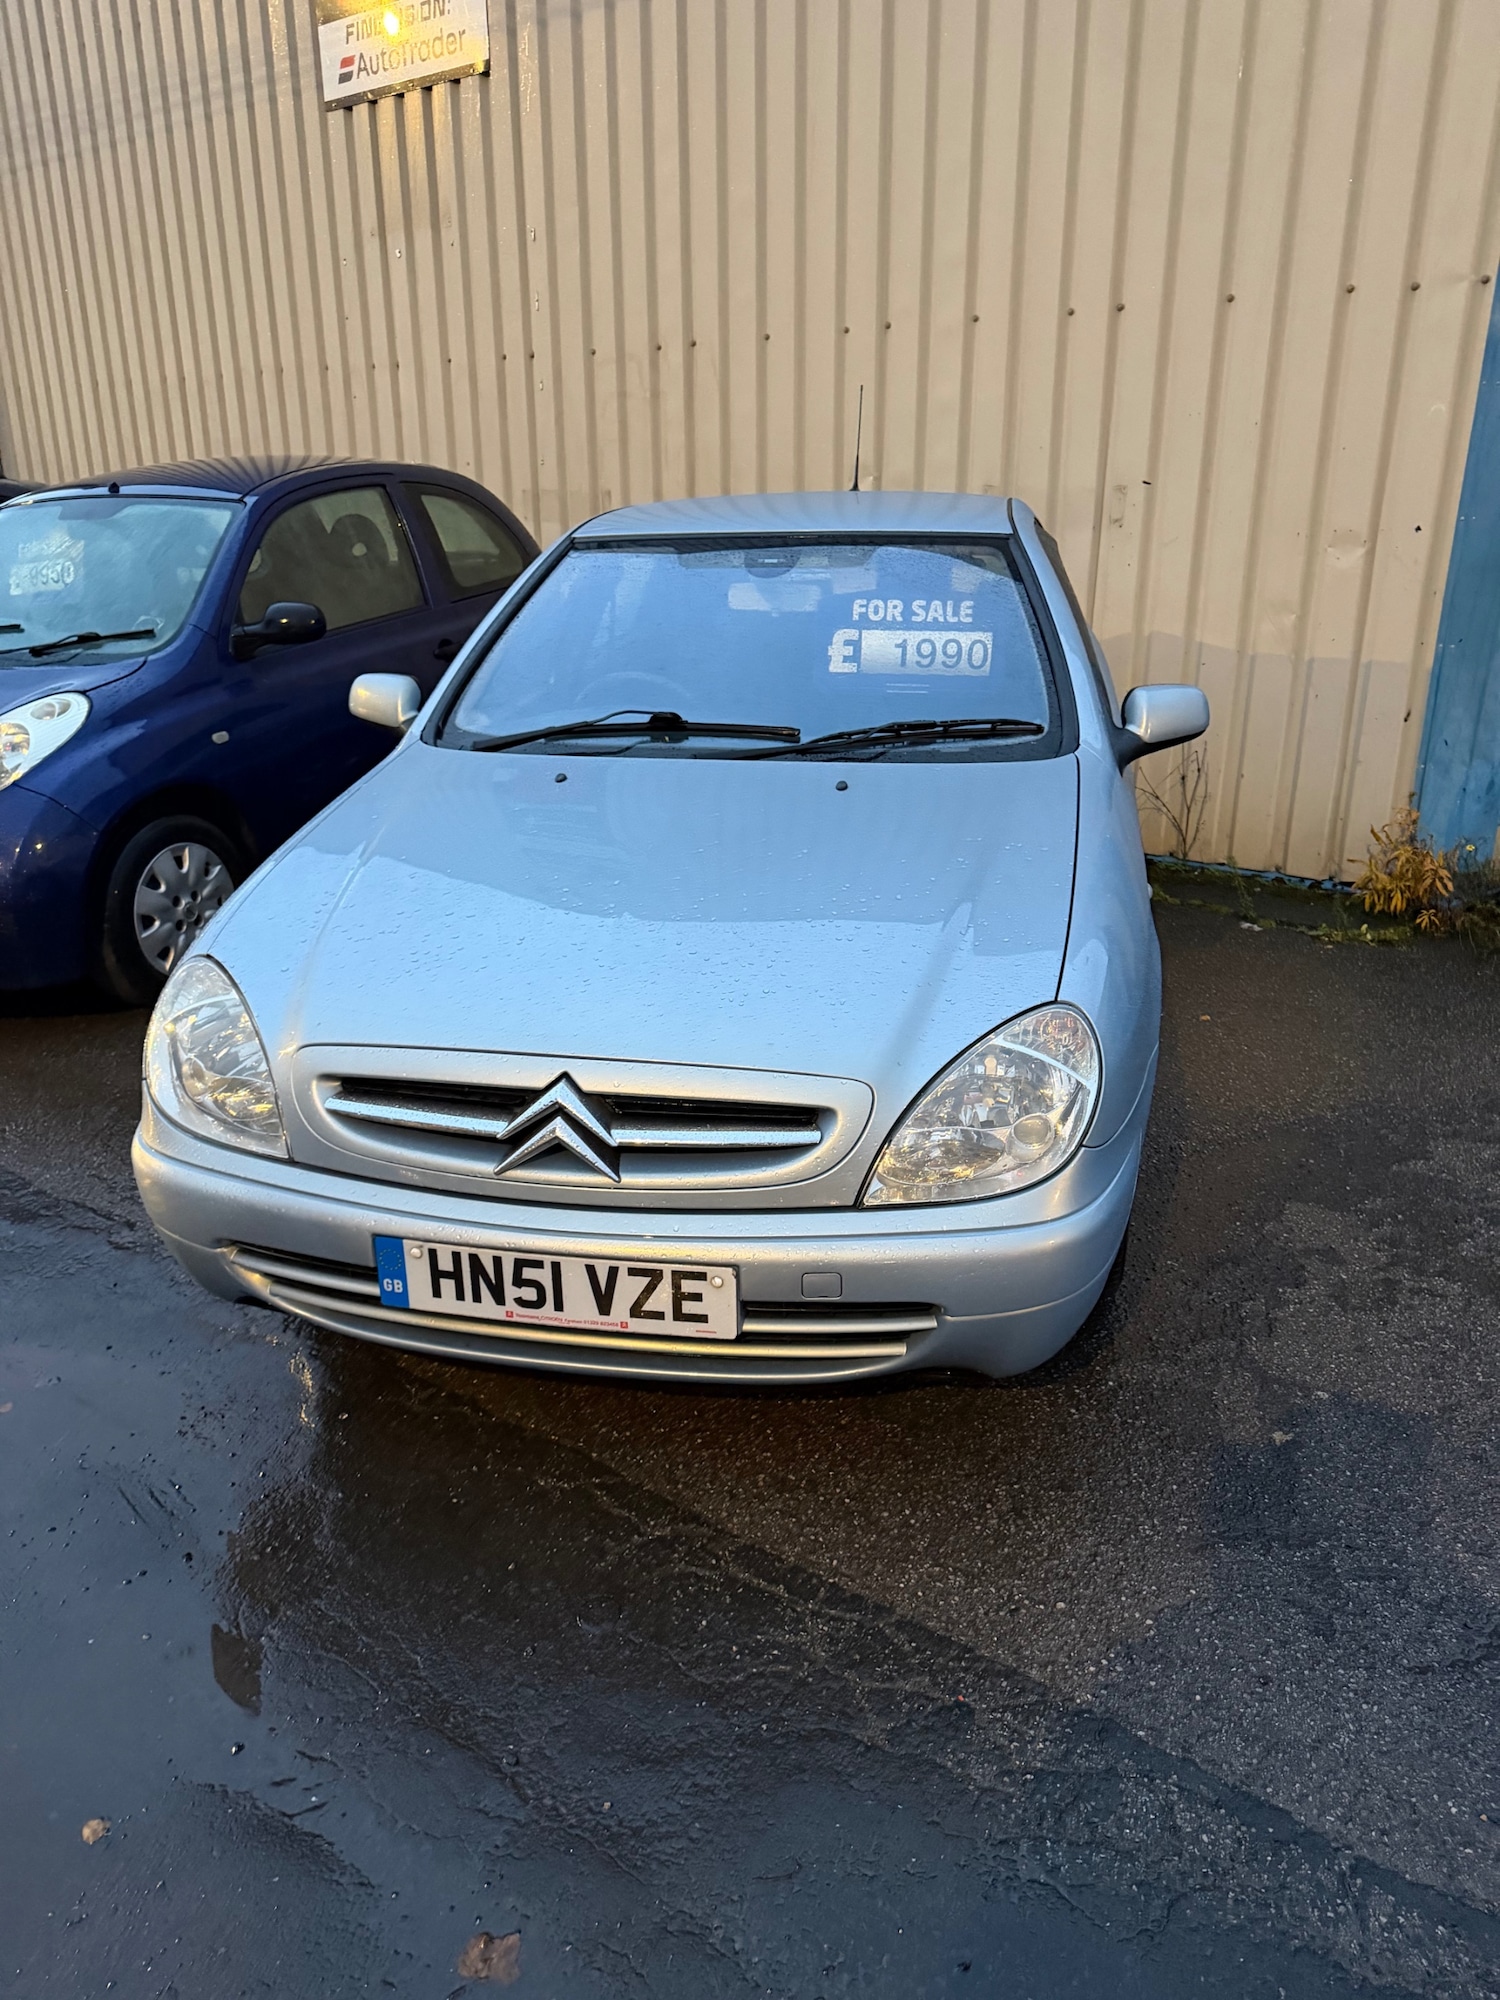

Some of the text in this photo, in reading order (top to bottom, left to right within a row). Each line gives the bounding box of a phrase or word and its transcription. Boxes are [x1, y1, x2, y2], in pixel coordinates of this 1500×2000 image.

[356, 28, 467, 80] AutoTrader
[852, 599, 974, 623] FOR SALE
[827, 628, 989, 673] £ 1990
[383, 1277, 404, 1294] GB
[427, 1247, 709, 1324] HN51 VZE
